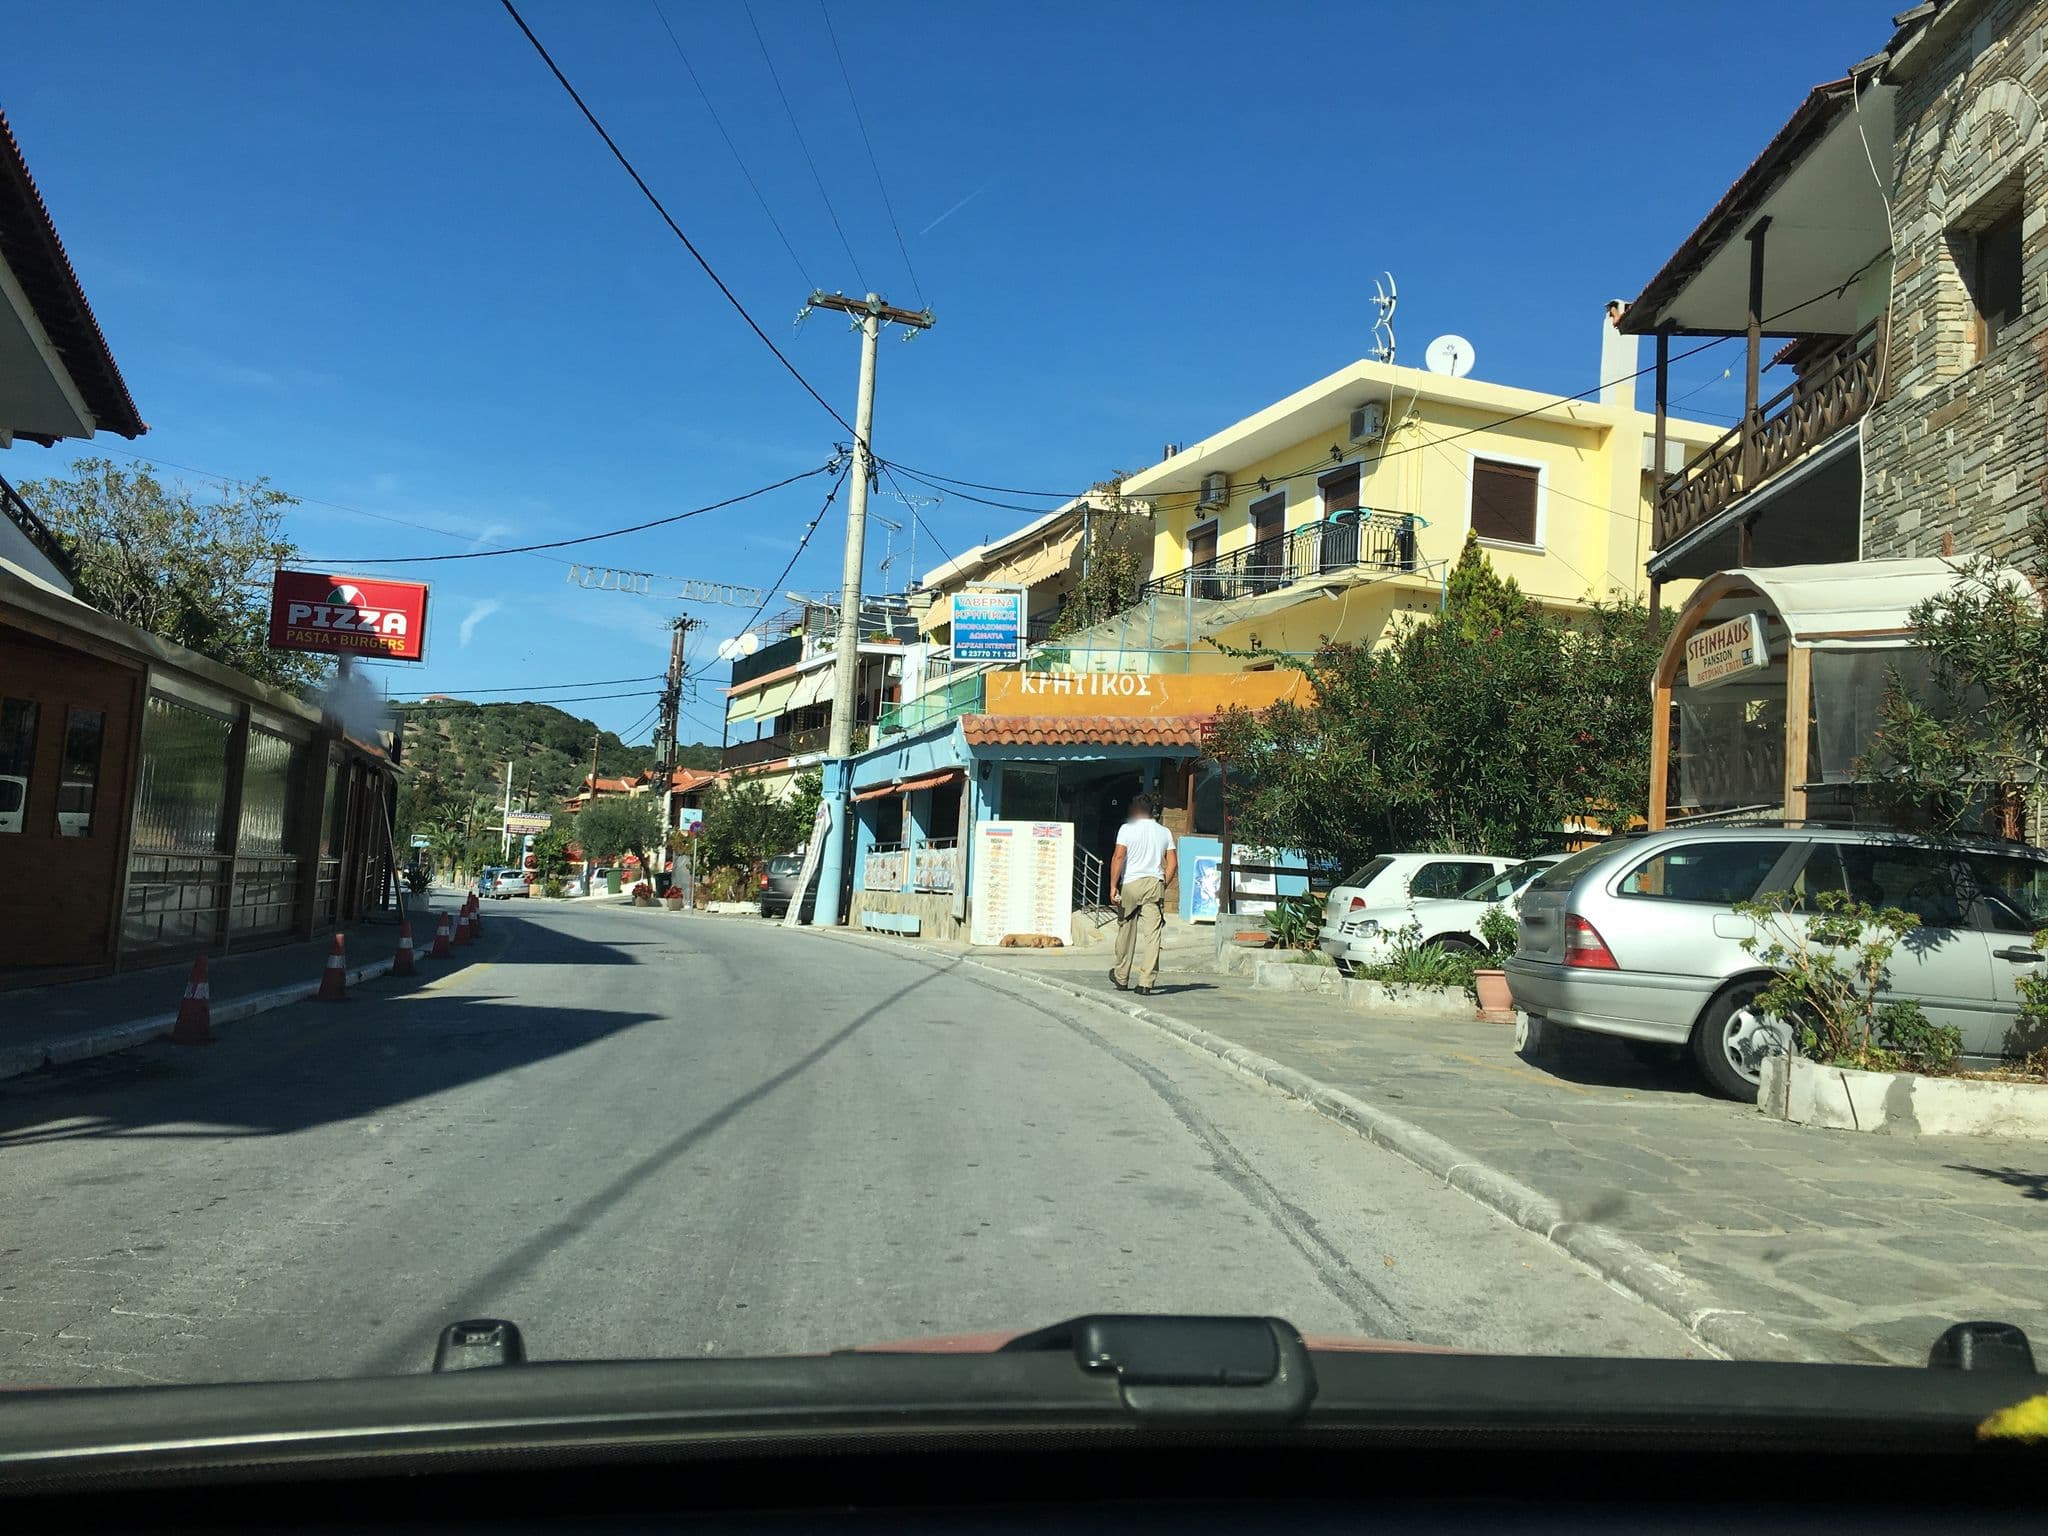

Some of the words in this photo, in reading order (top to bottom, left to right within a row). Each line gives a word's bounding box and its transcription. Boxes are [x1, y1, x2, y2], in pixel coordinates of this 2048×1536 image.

[287, 603, 407, 635] PIZZA
[286, 630, 330, 646] PASTA
[340, 634, 405, 651] BURGERS
[1688, 620, 1749, 661] STEINHAUS
[1703, 649, 1733, 669] PANSION
[1021, 672, 1152, 696] ΚΡΗΤΙΚΟΣ
